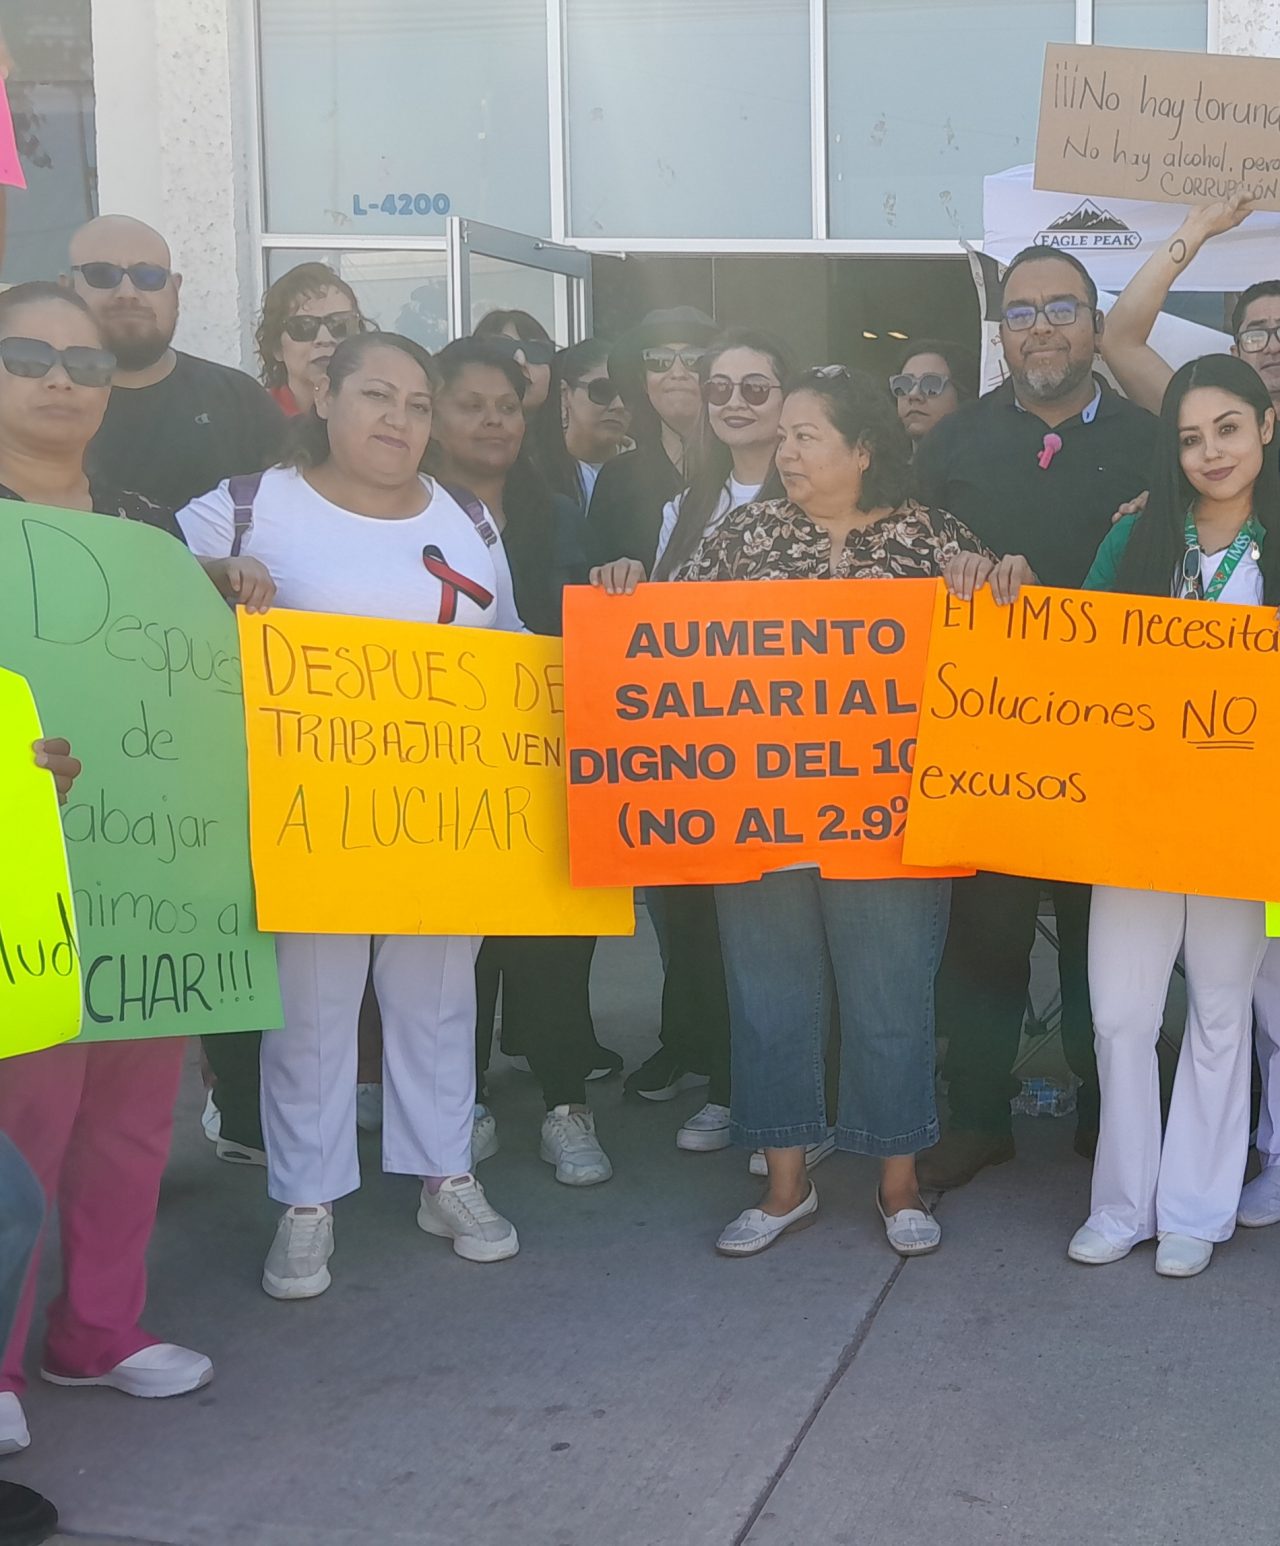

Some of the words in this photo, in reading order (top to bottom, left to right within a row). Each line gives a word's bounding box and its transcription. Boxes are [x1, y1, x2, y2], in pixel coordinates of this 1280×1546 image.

[1139, 75, 1186, 140] hay
[1063, 125, 1099, 160] No
[1113, 129, 1150, 182] hay
[353, 193, 450, 215] L-4200
[1041, 235, 1088, 247] EAGLE
[625, 618, 906, 659] AUMENTO
[1007, 596, 1097, 643] IMSS
[1123, 608, 1280, 653] necesita
[262, 623, 487, 711] DESPUES
[514, 662, 564, 714] DE
[615, 678, 918, 721] SALARIAL
[931, 662, 1155, 731] Soluciones
[1182, 690, 1257, 740] NO
[122, 700, 180, 761] de
[259, 707, 498, 768] TRABAJAR
[501, 732, 561, 767] VEN
[570, 743, 736, 785] DIGNO
[756, 741, 859, 779] DEL
[872, 738, 917, 774] 10
[920, 765, 1087, 803] excusas
[62, 788, 219, 864] abajar
[277, 784, 312, 854] A
[341, 785, 544, 854] LUCHAR
[618, 802, 715, 848] (NO
[735, 807, 804, 845] AL
[73, 881, 197, 934] nimos
[218, 903, 240, 937] a
[0, 892, 81, 985] lud
[84, 950, 256, 1023] CHAR!!!
